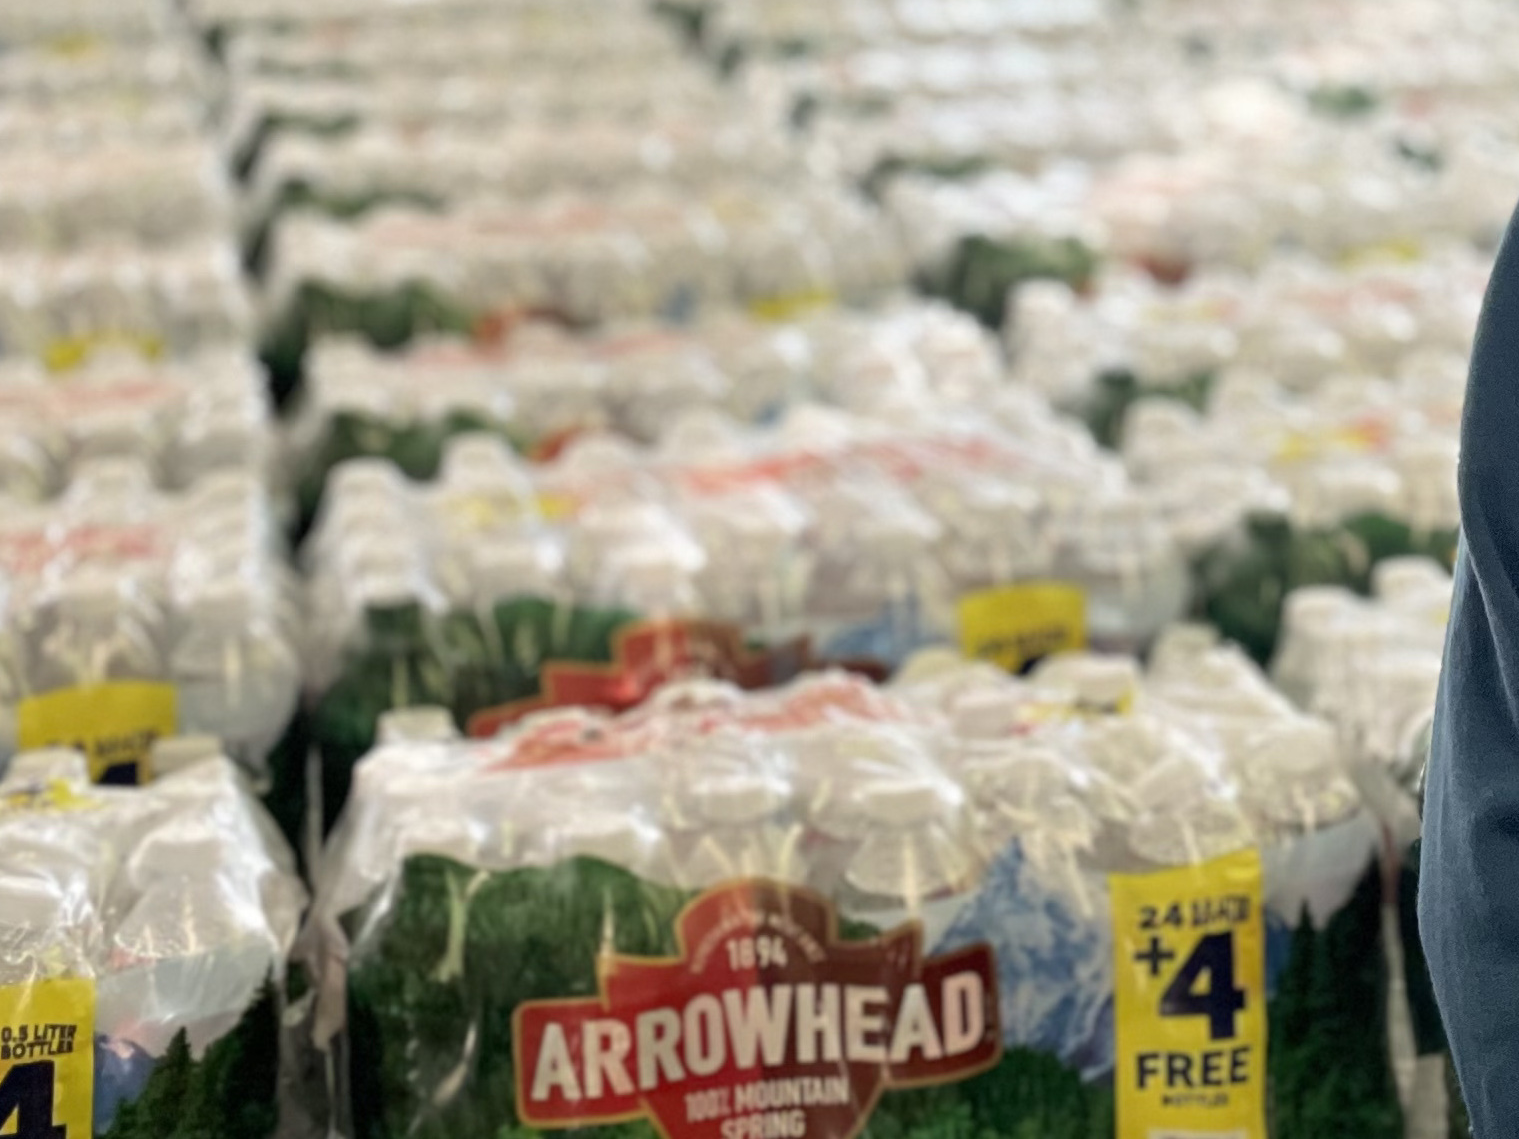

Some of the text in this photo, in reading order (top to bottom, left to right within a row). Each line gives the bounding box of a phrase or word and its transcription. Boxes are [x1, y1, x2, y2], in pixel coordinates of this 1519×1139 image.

[530, 971, 986, 1101] ARROWHEAD
[1136, 1047, 1250, 1089] FREE
[734, 1076, 850, 1112] MOUNTAIN
[720, 1109, 806, 1139] SPRING
